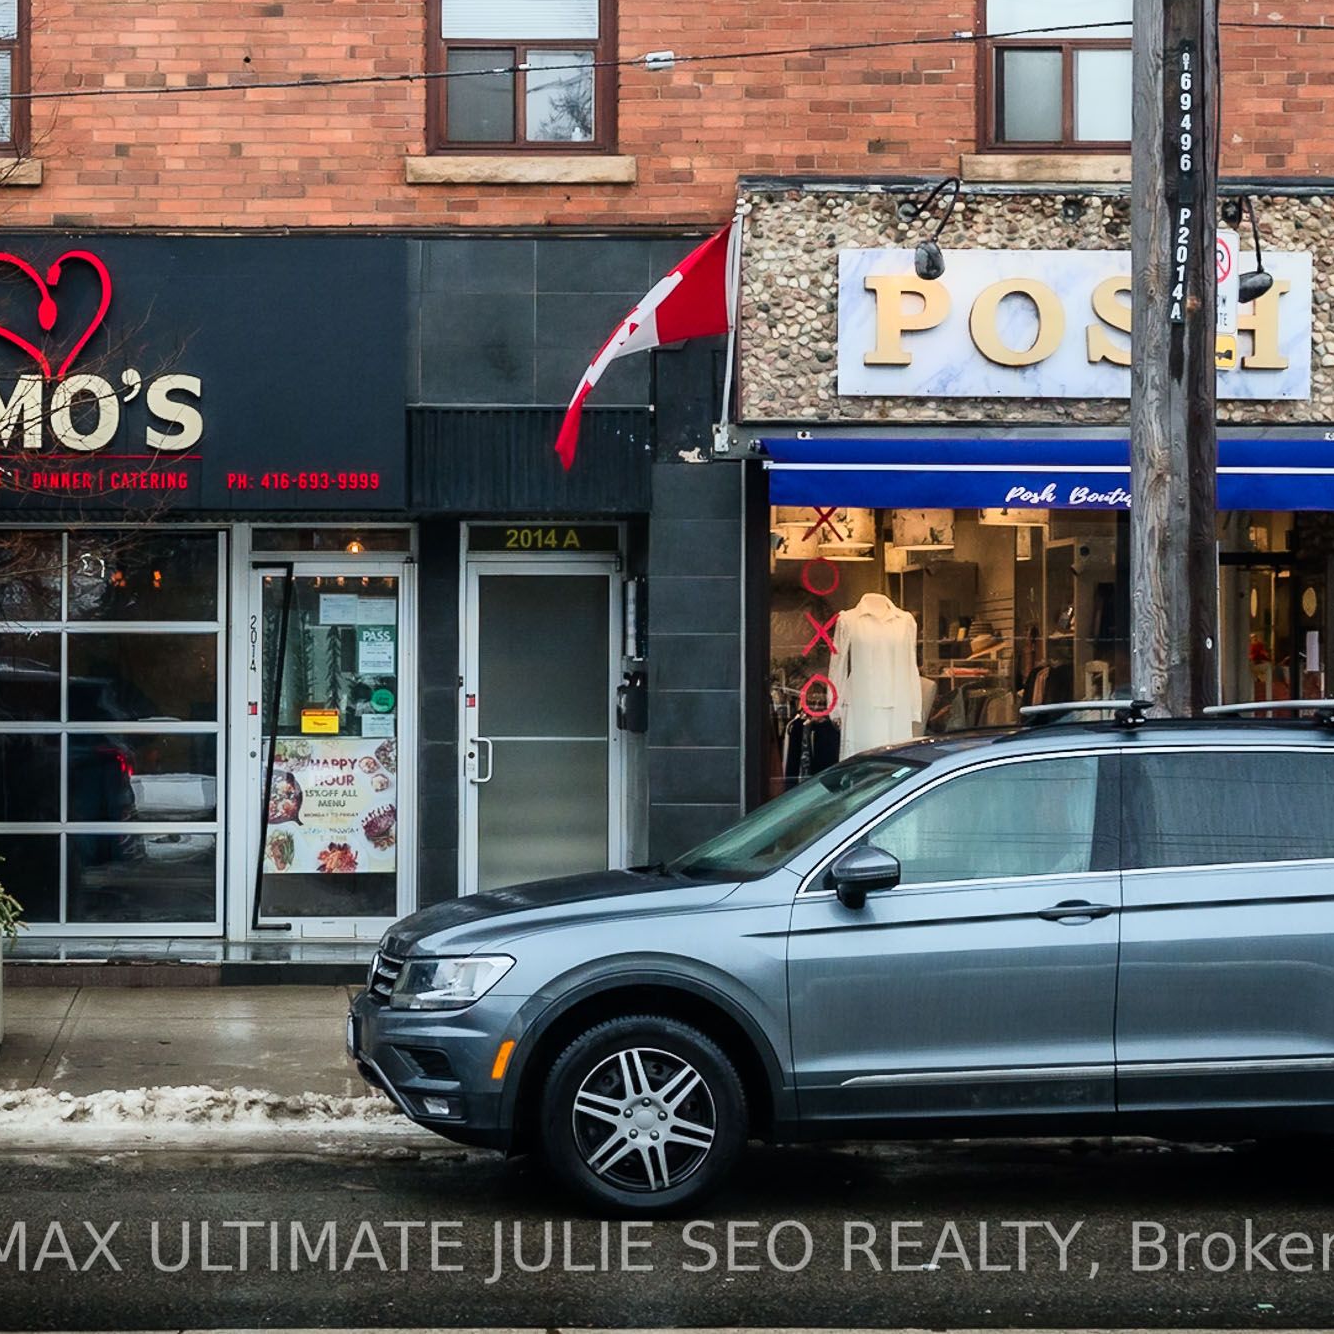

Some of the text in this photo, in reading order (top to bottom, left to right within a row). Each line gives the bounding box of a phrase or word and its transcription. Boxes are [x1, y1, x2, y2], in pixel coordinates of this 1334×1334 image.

[1170, 208, 1192, 319] P2014A
[32, 471, 93, 490] DINNER
[111, 471, 188, 490] CATERING
[227, 472, 255, 490] PH:
[260, 472, 380, 490] 416-693-9999
[1005, 483, 1057, 504] Posh
[506, 528, 581, 549] 2014 A
[250, 614, 258, 673] 2014
[362, 630, 391, 642] PASS
[310, 758, 358, 770] HAPPY
[318, 800, 346, 808] MENU
